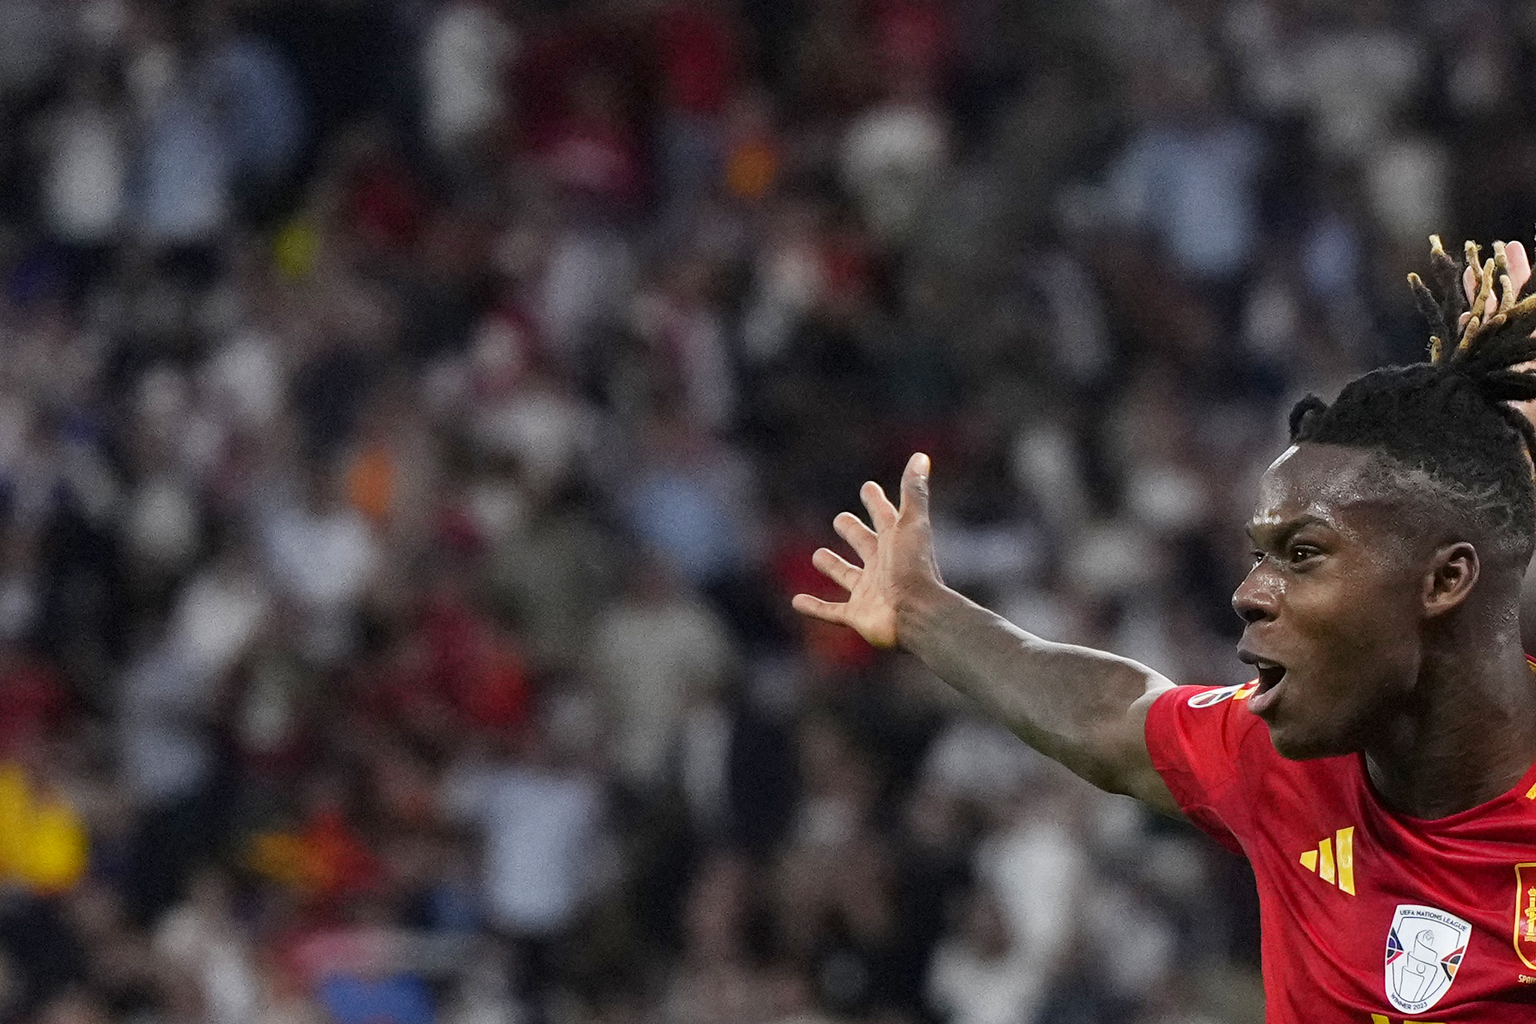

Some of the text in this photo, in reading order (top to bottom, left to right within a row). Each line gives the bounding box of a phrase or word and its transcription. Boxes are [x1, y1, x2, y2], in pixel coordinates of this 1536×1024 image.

[1416, 911, 1442, 921] NATIONS
[1443, 917, 1468, 932] LEAGUE
[1391, 992, 1428, 1010] WINNER 2023
